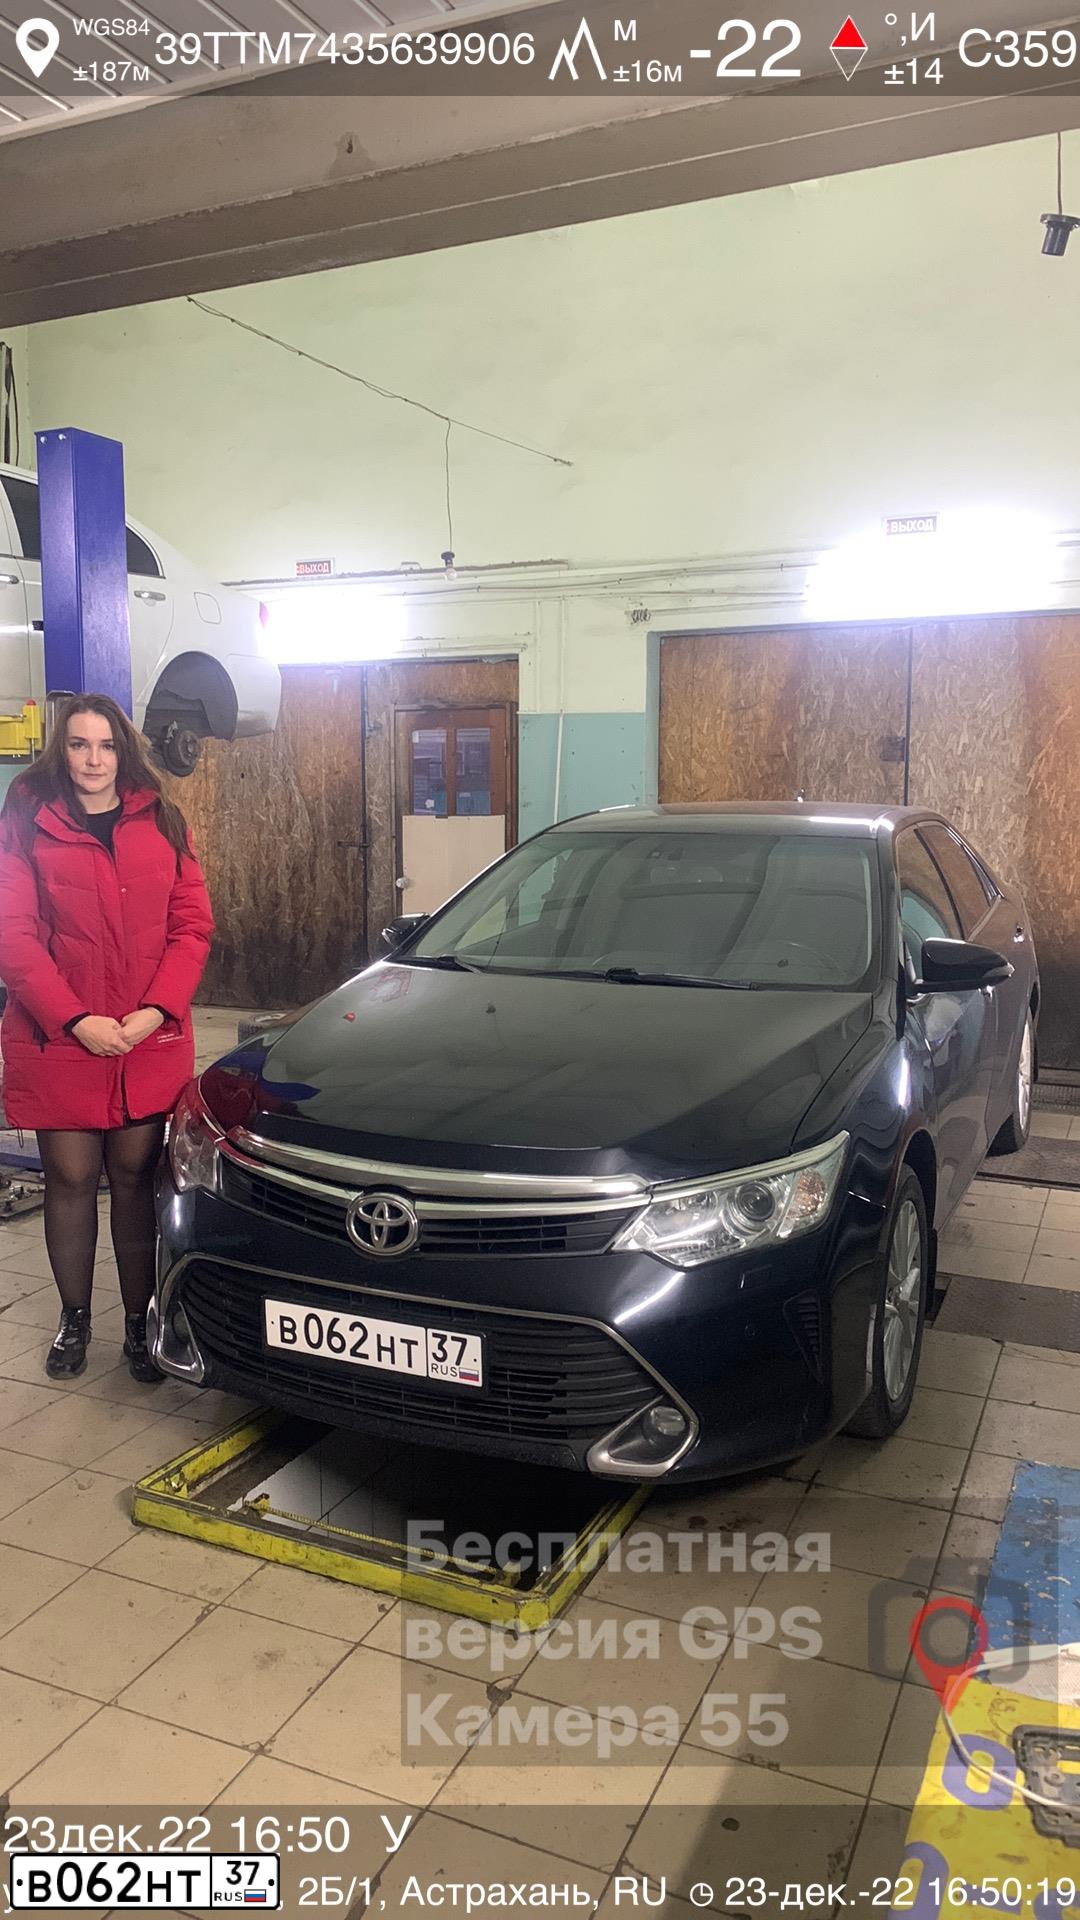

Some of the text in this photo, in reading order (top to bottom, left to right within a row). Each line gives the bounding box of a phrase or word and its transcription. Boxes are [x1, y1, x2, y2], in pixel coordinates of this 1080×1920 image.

[890, 518, 934, 533] ВЫХОД
[297, 562, 329, 575] ВЫХОД
[431, 1333, 467, 1366] 37
[430, 1362, 458, 1378] RUS
